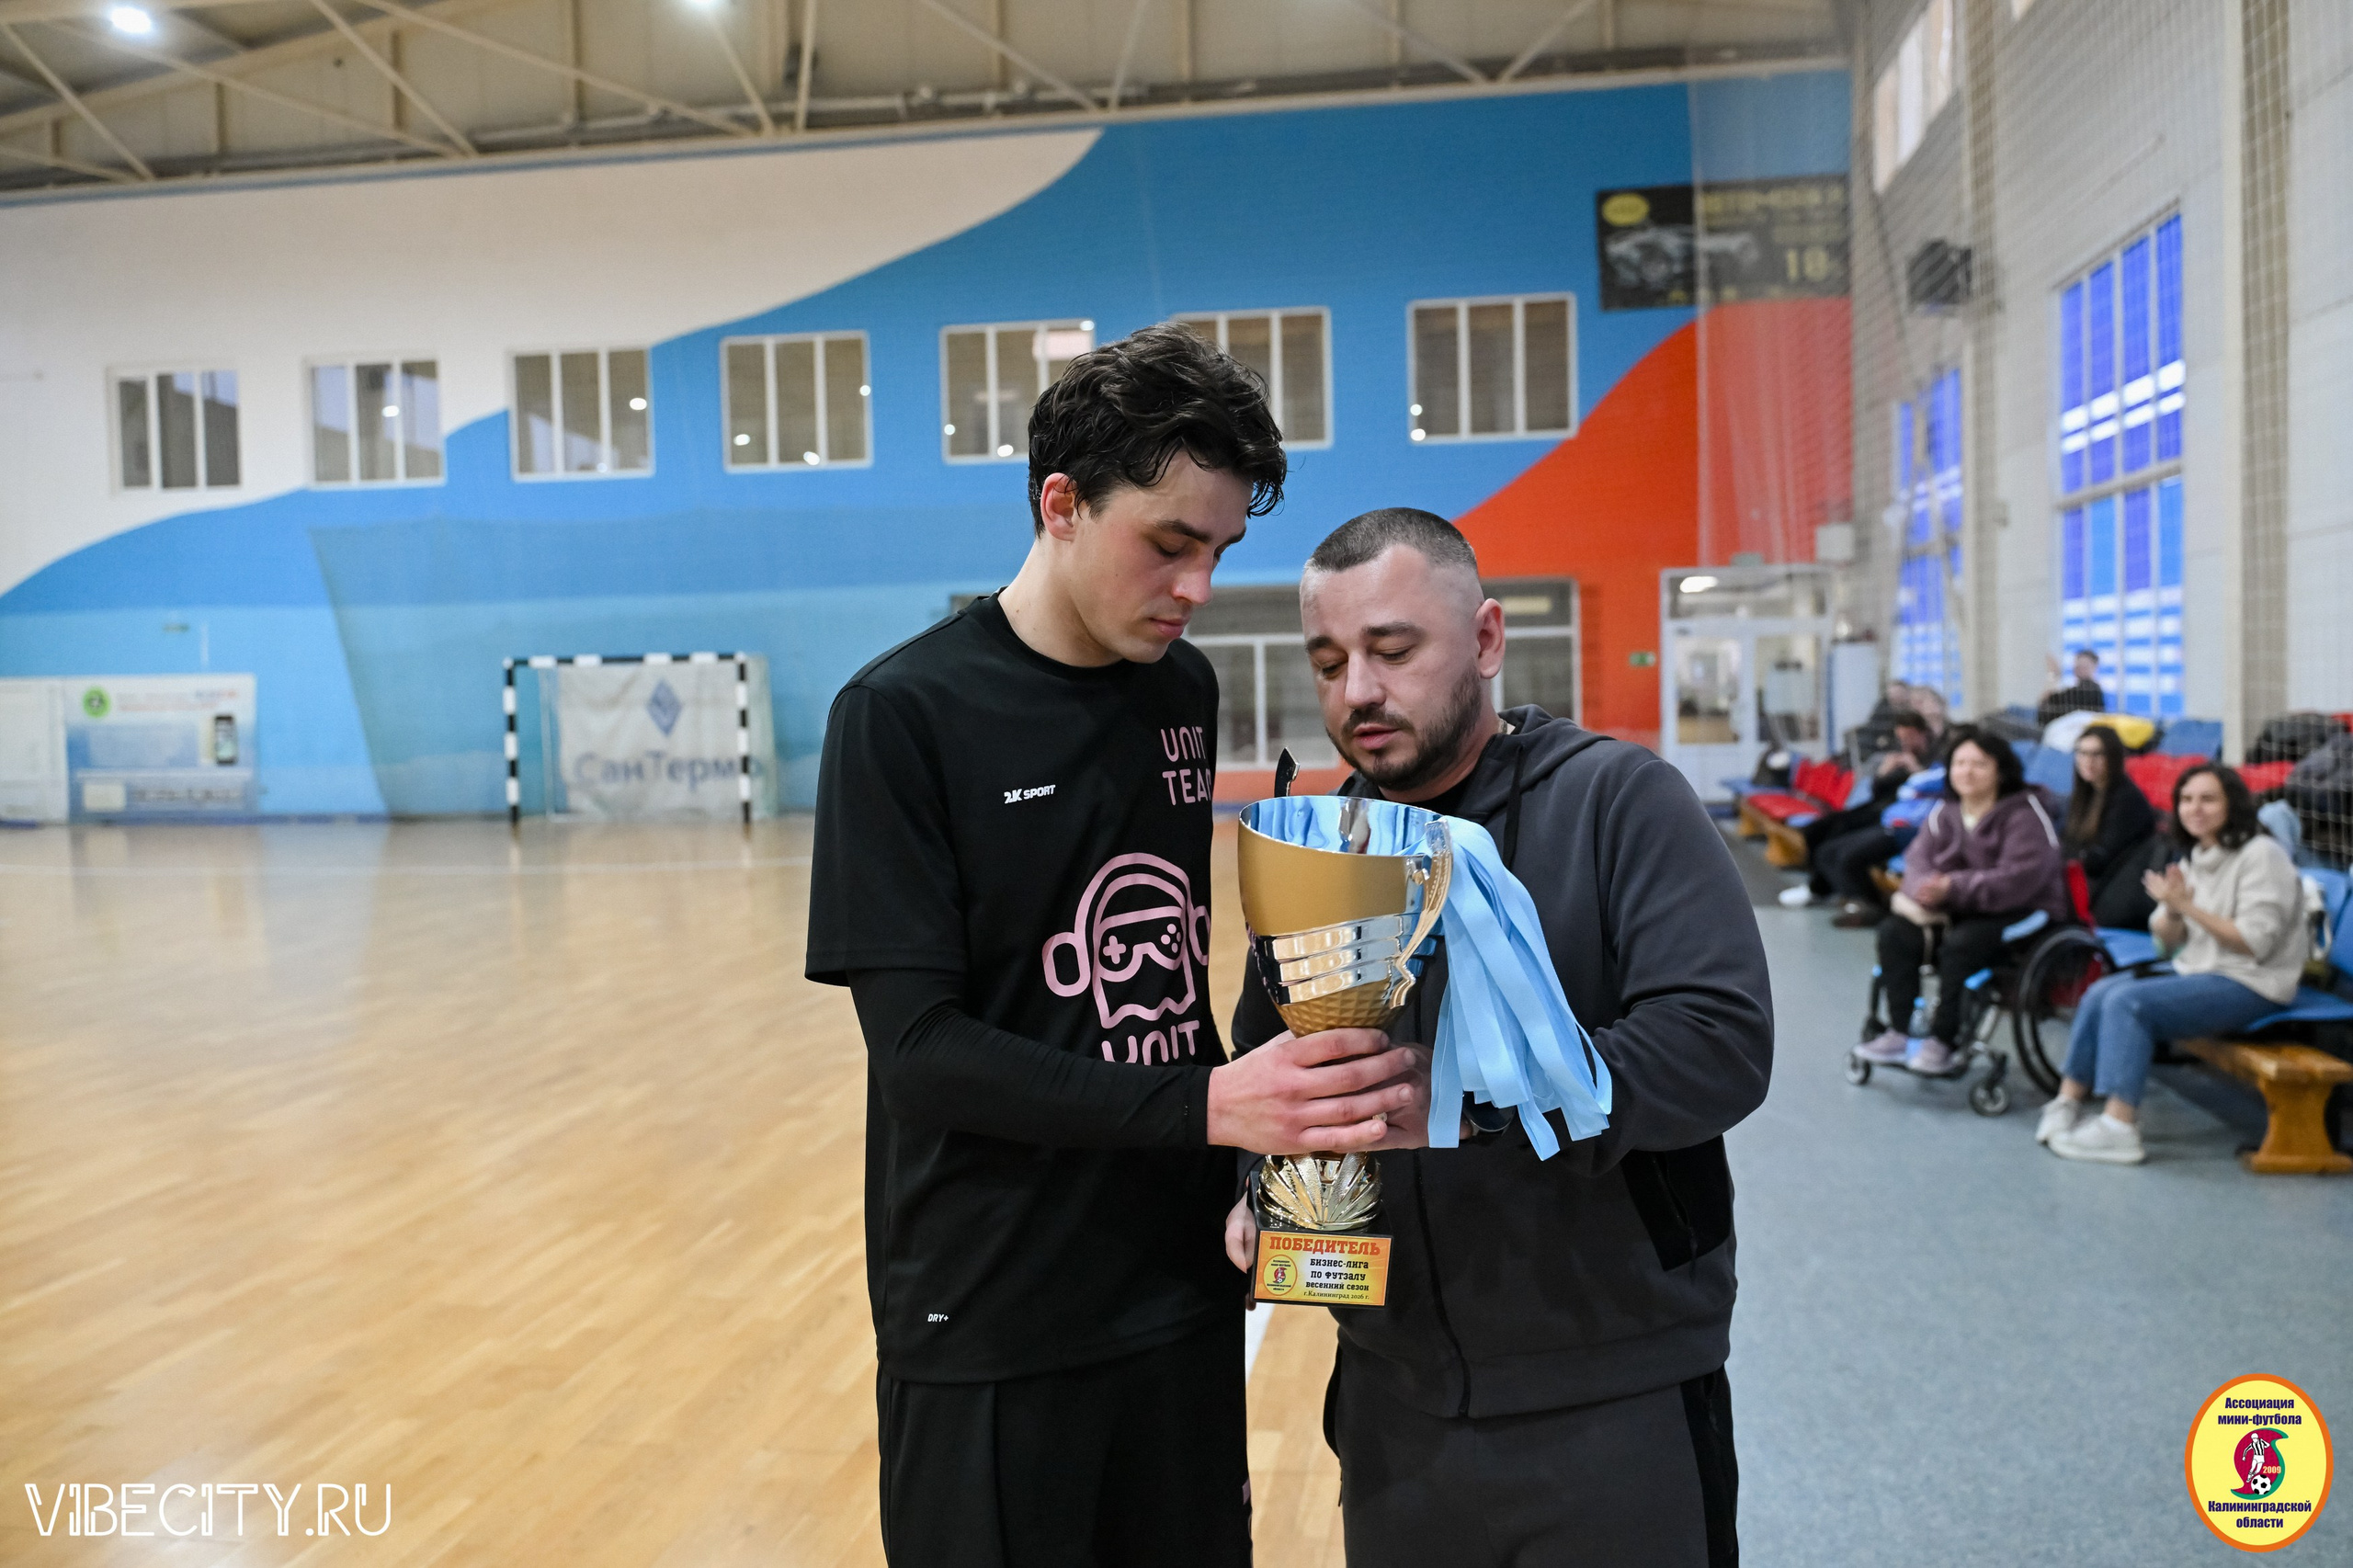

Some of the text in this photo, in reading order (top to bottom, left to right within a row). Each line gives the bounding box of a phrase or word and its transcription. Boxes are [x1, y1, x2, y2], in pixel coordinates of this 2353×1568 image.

[1161, 726, 1206, 762] UNIT
[1023, 784, 1056, 800] SPORT
[1102, 1019, 1200, 1066] UNIT
[1269, 1236, 1381, 1256] ПОБЕДИТЕЛЬ
[1305, 1281, 1370, 1291] весенний сезон
